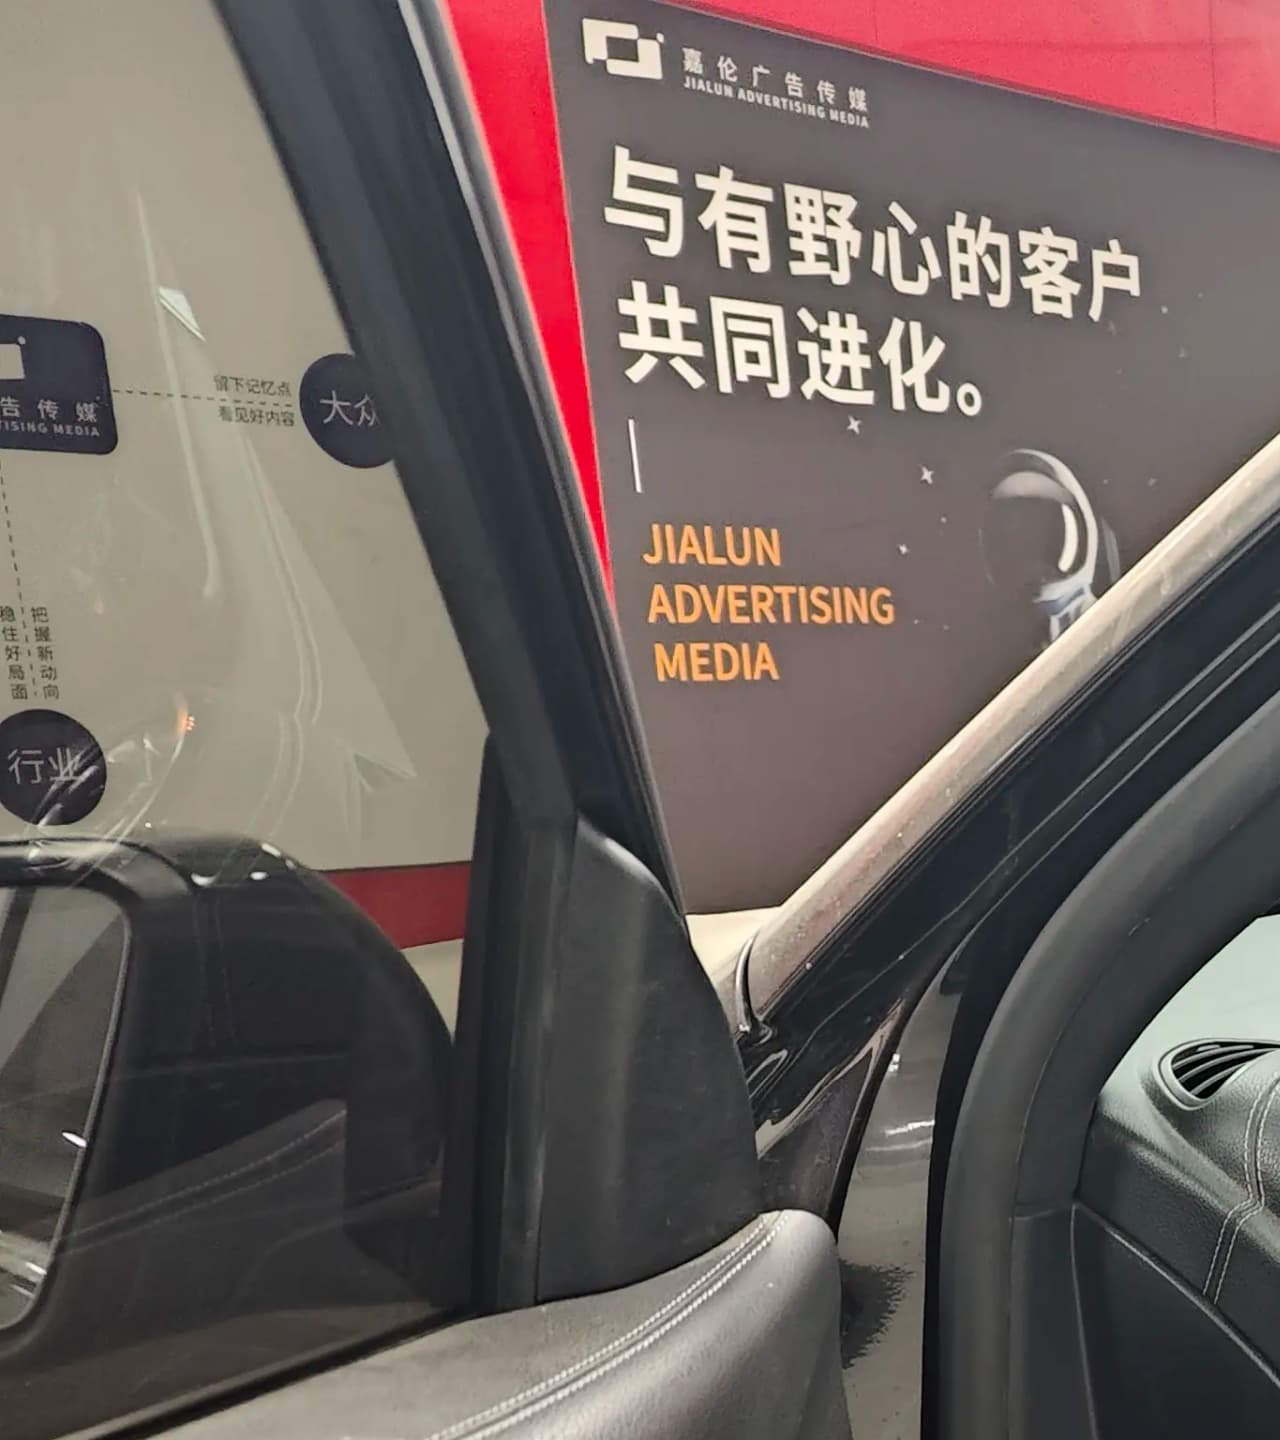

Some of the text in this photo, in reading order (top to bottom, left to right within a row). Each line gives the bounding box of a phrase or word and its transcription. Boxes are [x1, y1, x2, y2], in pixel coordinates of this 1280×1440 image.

[682, 47, 868, 112] 嘉伦广告传媒
[684, 76, 869, 128] JIALUN ADVERTISING MEDIA
[603, 144, 1141, 322] 与有野心的客户
[616, 279, 983, 417] 共同进化。
[53, 423, 100, 437] MEDIA
[643, 523, 782, 567] JIALUN
[648, 583, 895, 625] ADVERTISING
[653, 641, 780, 682] MEDIA
[8, 747, 82, 785] 行业
